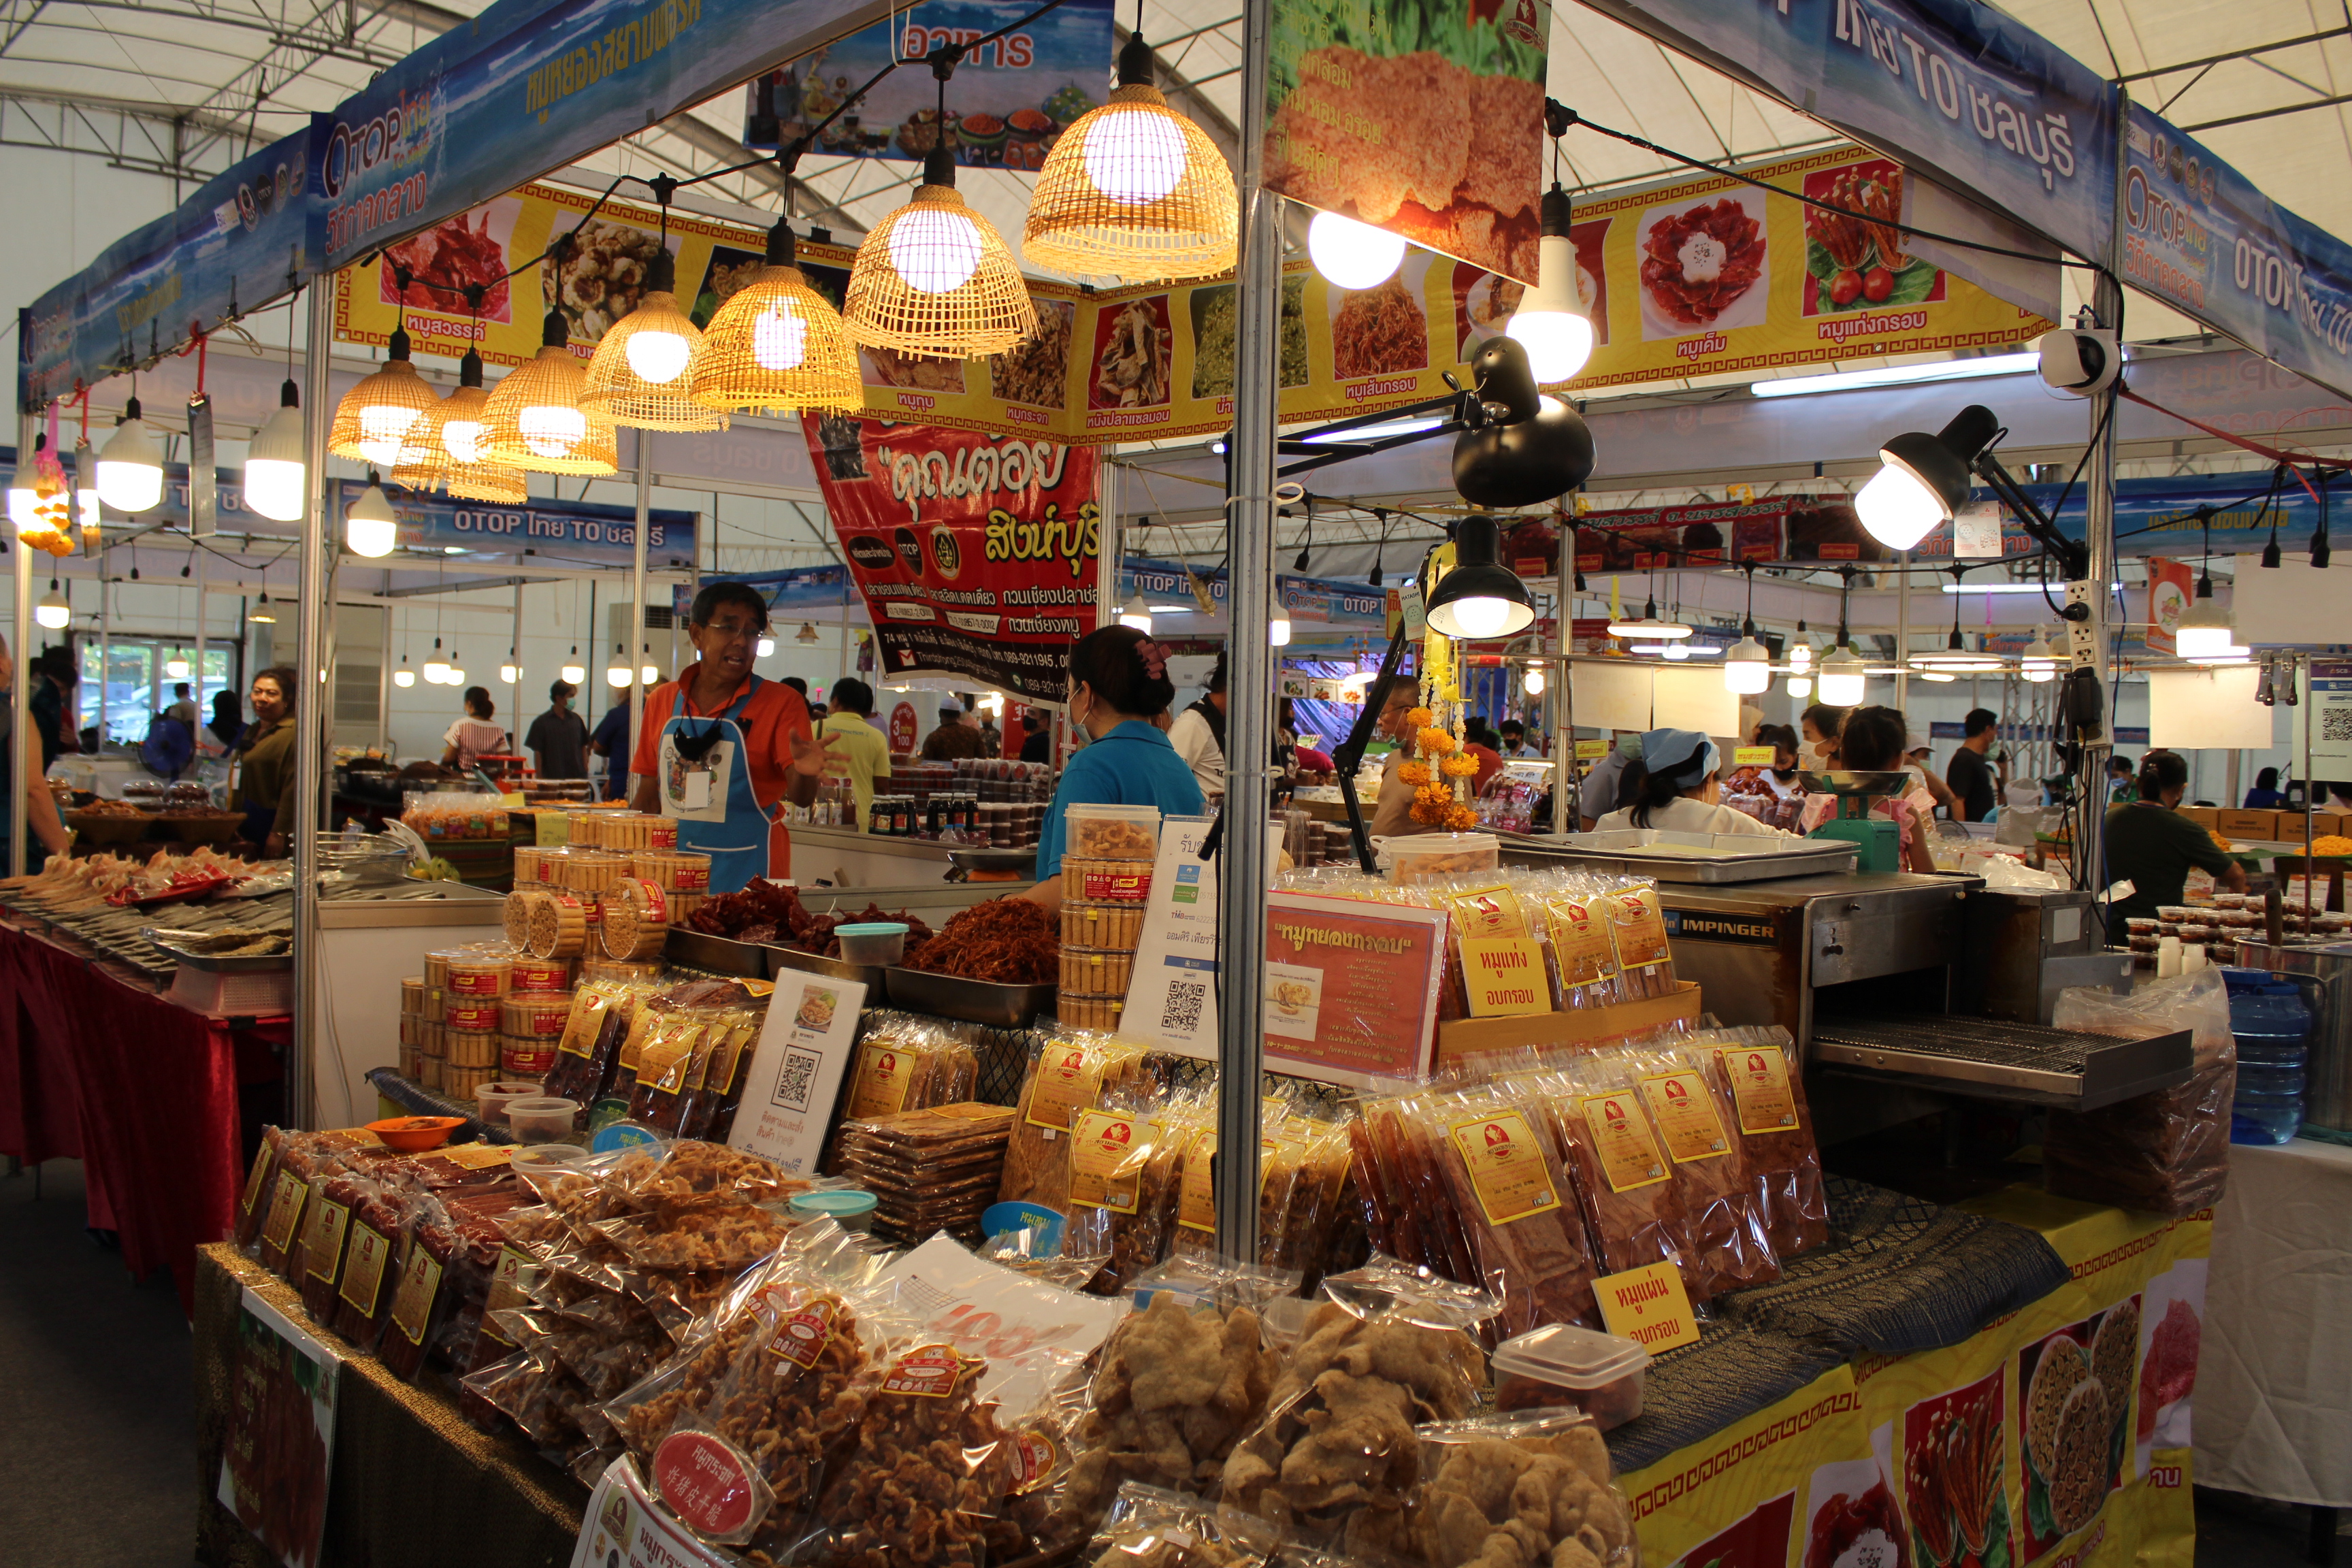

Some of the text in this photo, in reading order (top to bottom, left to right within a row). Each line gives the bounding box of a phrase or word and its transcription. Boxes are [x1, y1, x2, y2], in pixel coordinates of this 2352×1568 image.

[900, 24, 1033, 68] อาหาร
[525, 0, 701, 125] หมูหยองสยามพอรค
[1275, 69, 1381, 145] ใหม่ หอม อร่อย
[1903, 32, 1959, 120] TO
[1968, 82, 2075, 191] ชลบุรี
[323, 88, 430, 199] OTOP ไทย
[2124, 164, 2187, 246] OTOP
[2234, 238, 2294, 312] OTOP
[406, 312, 485, 341] หมูสวรรค์
[1818, 311, 1928, 345] หมูแท่งกรอบ
[1676, 331, 1727, 359] หมูเค็ม
[897, 392, 934, 411] หมูทุบ
[1345, 377, 1416, 403] หมูเส้นกรอบ
[1006, 406, 1049, 426] หมูกระจก
[1085, 407, 1170, 429] หนังปลาแซลมอน
[1666, 495, 1793, 523] จ.นครสวรรค์
[454, 510, 665, 549] OTOP ไทย TO ชลรี
[898, 543, 918, 555] OTOP
[1002, 584, 1098, 604] กวนเชียงปลาช่อ
[1133, 574, 1173, 591] OTOP
[1286, 591, 1316, 608] OTOP
[1343, 598, 1378, 613] OTOP
[1401, 591, 1420, 601] HATASHI
[885, 634, 895, 644] 74
[893, 719, 900, 736] 3
[897, 736, 910, 746] 100
[1737, 750, 1771, 763] หมูสวรรค์
[1171, 911, 1185, 919] TMB
[1166, 930, 1190, 943] ออมศิริ
[1681, 917, 1775, 938] IMPINGER
[1480, 942, 1528, 979] หมูแท่ง
[1485, 988, 1534, 1006] อบกรอบ
[755, 1125, 775, 1142] สินค้า
[761, 1110, 804, 1134] ติดตามและสั่ง
[1615, 1269, 1669, 1316] หมูแผ่น
[1629, 1318, 1680, 1344] อบกรอบ
[691, 1444, 736, 1488] หมูกระจก
